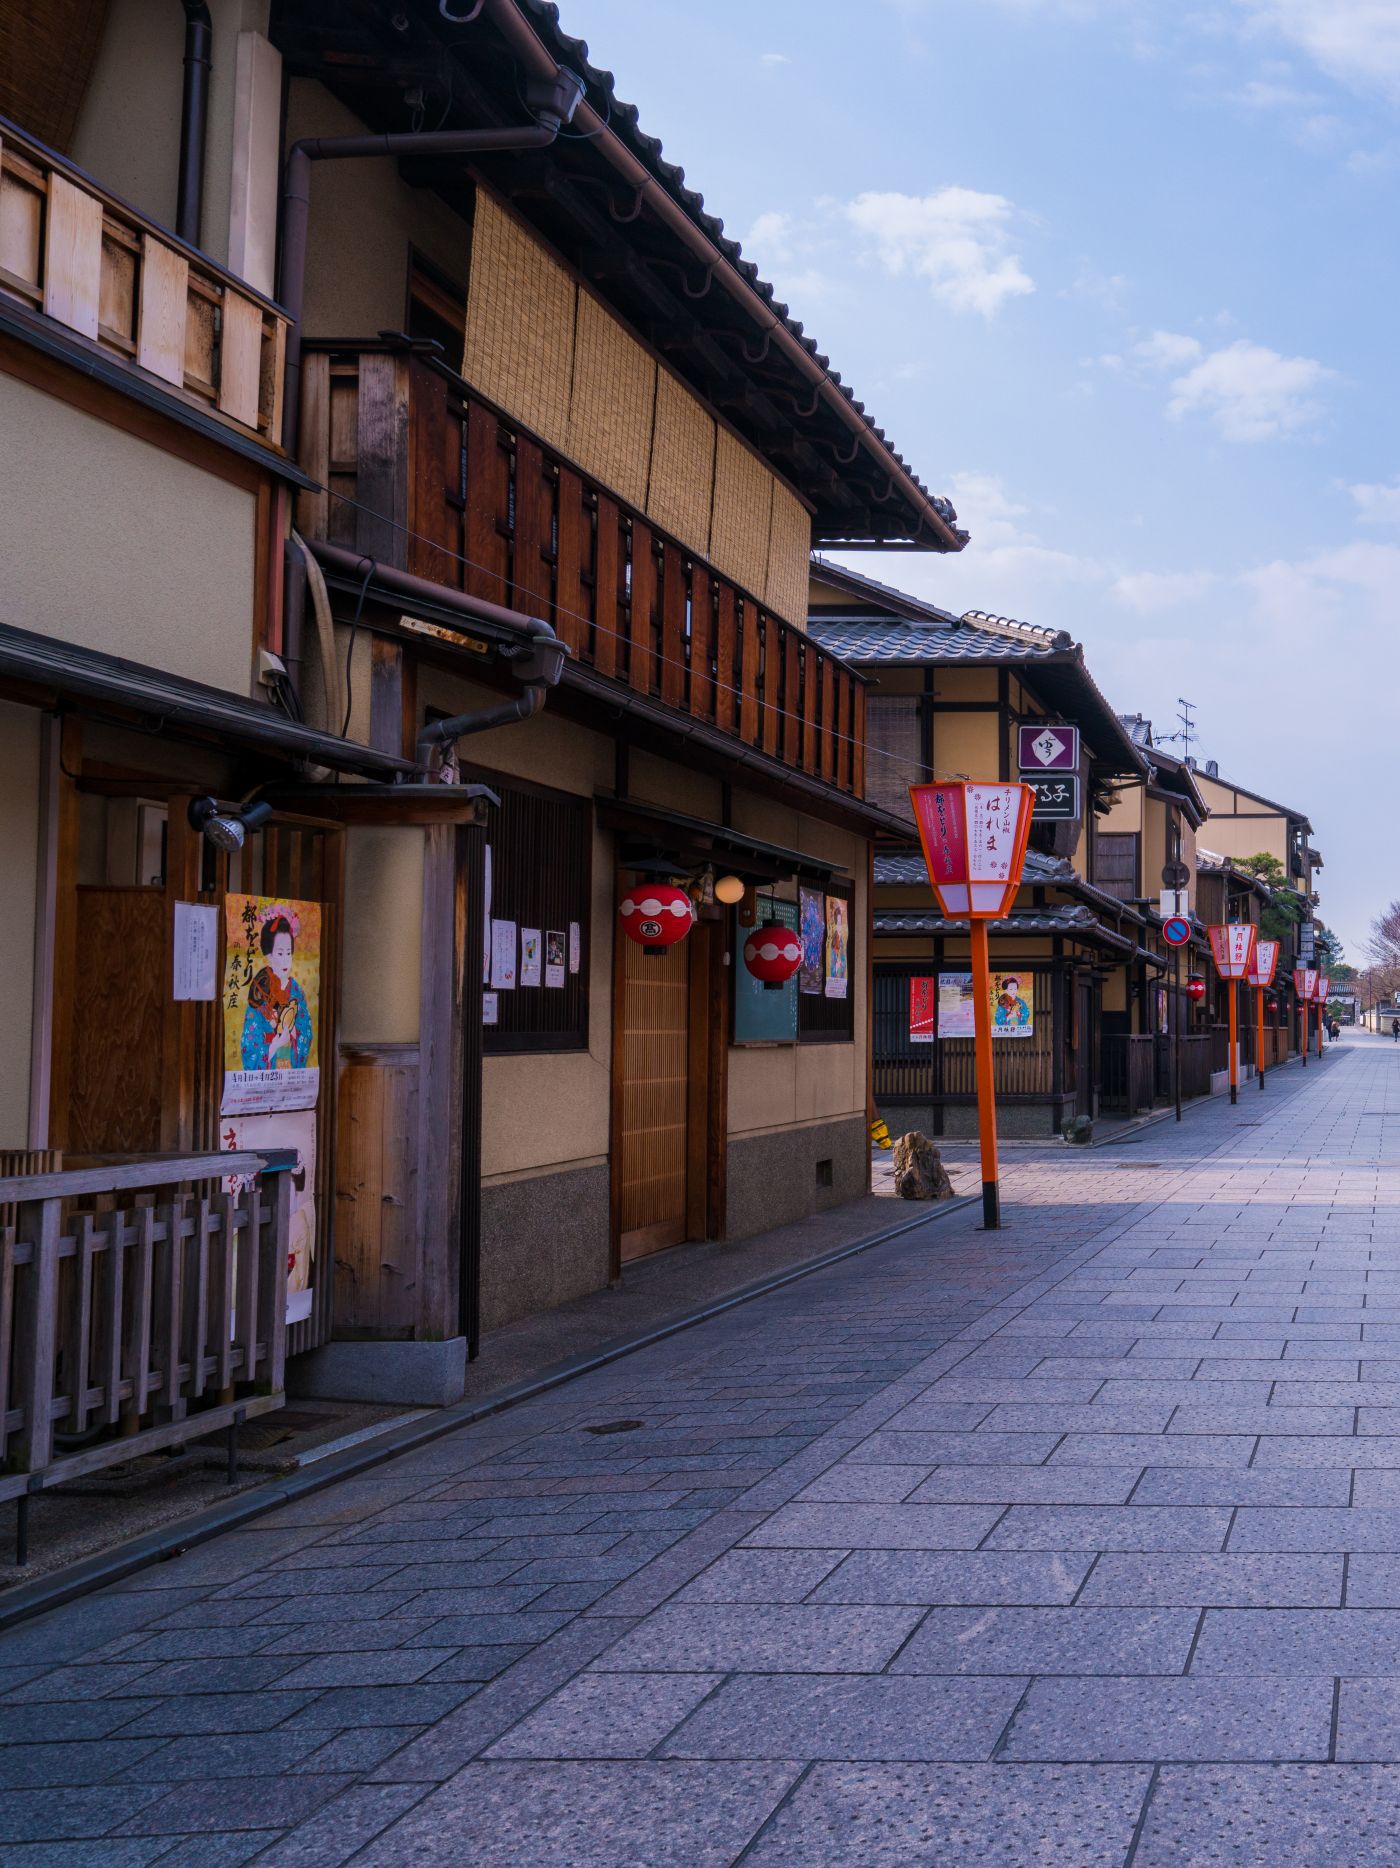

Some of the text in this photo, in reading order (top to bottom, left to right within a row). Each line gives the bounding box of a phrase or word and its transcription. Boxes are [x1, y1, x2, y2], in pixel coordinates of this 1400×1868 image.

[1029, 783, 1070, 802] る子
[986, 796, 1001, 852] はれま
[241, 900, 259, 987] 都をどり
